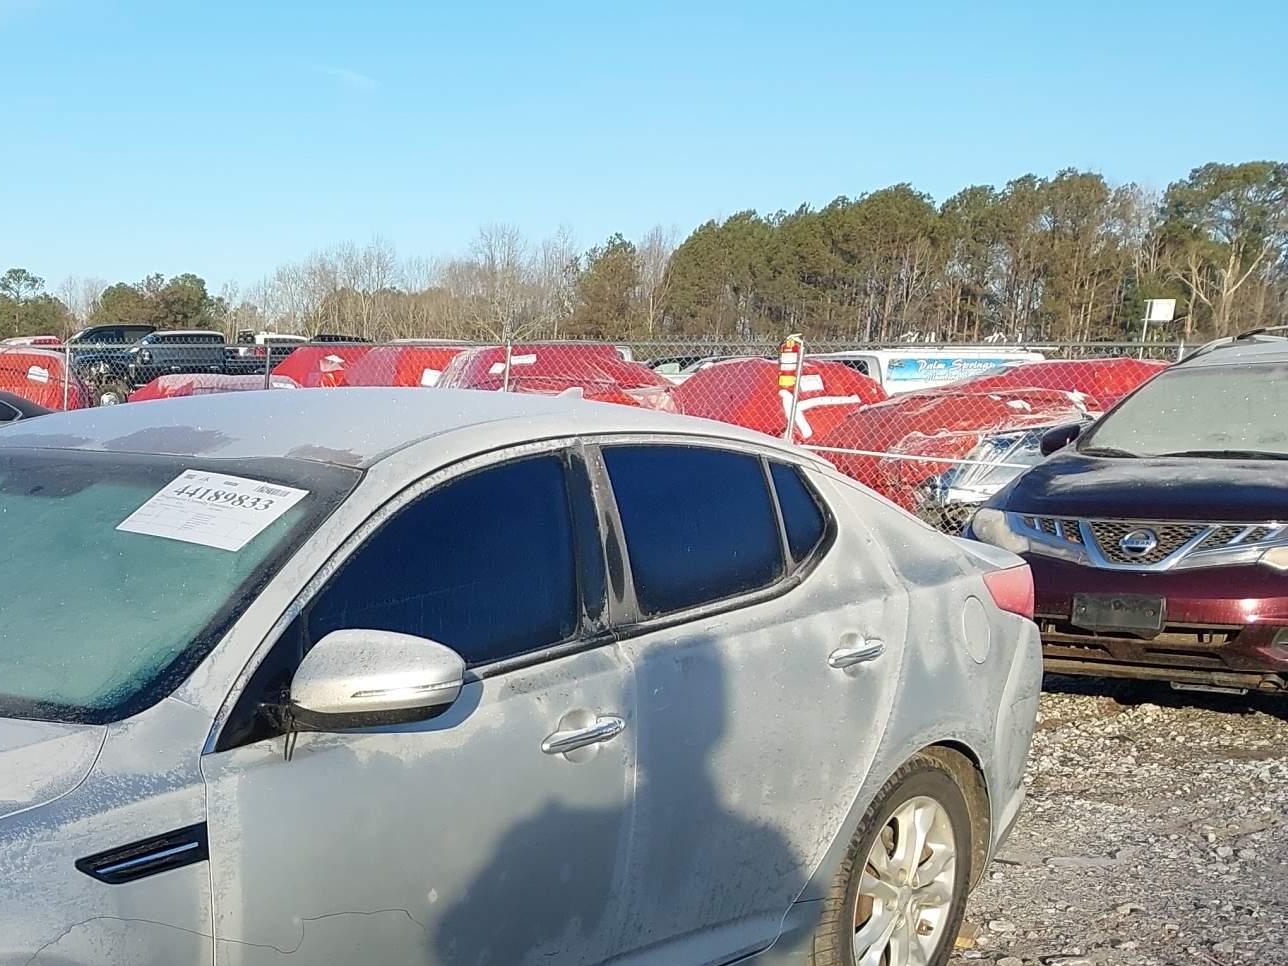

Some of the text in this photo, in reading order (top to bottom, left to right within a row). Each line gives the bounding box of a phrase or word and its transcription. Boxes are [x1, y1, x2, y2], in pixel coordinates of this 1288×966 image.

[917, 358, 996, 372] Palm Springs
[173, 484, 275, 511] 44189833
